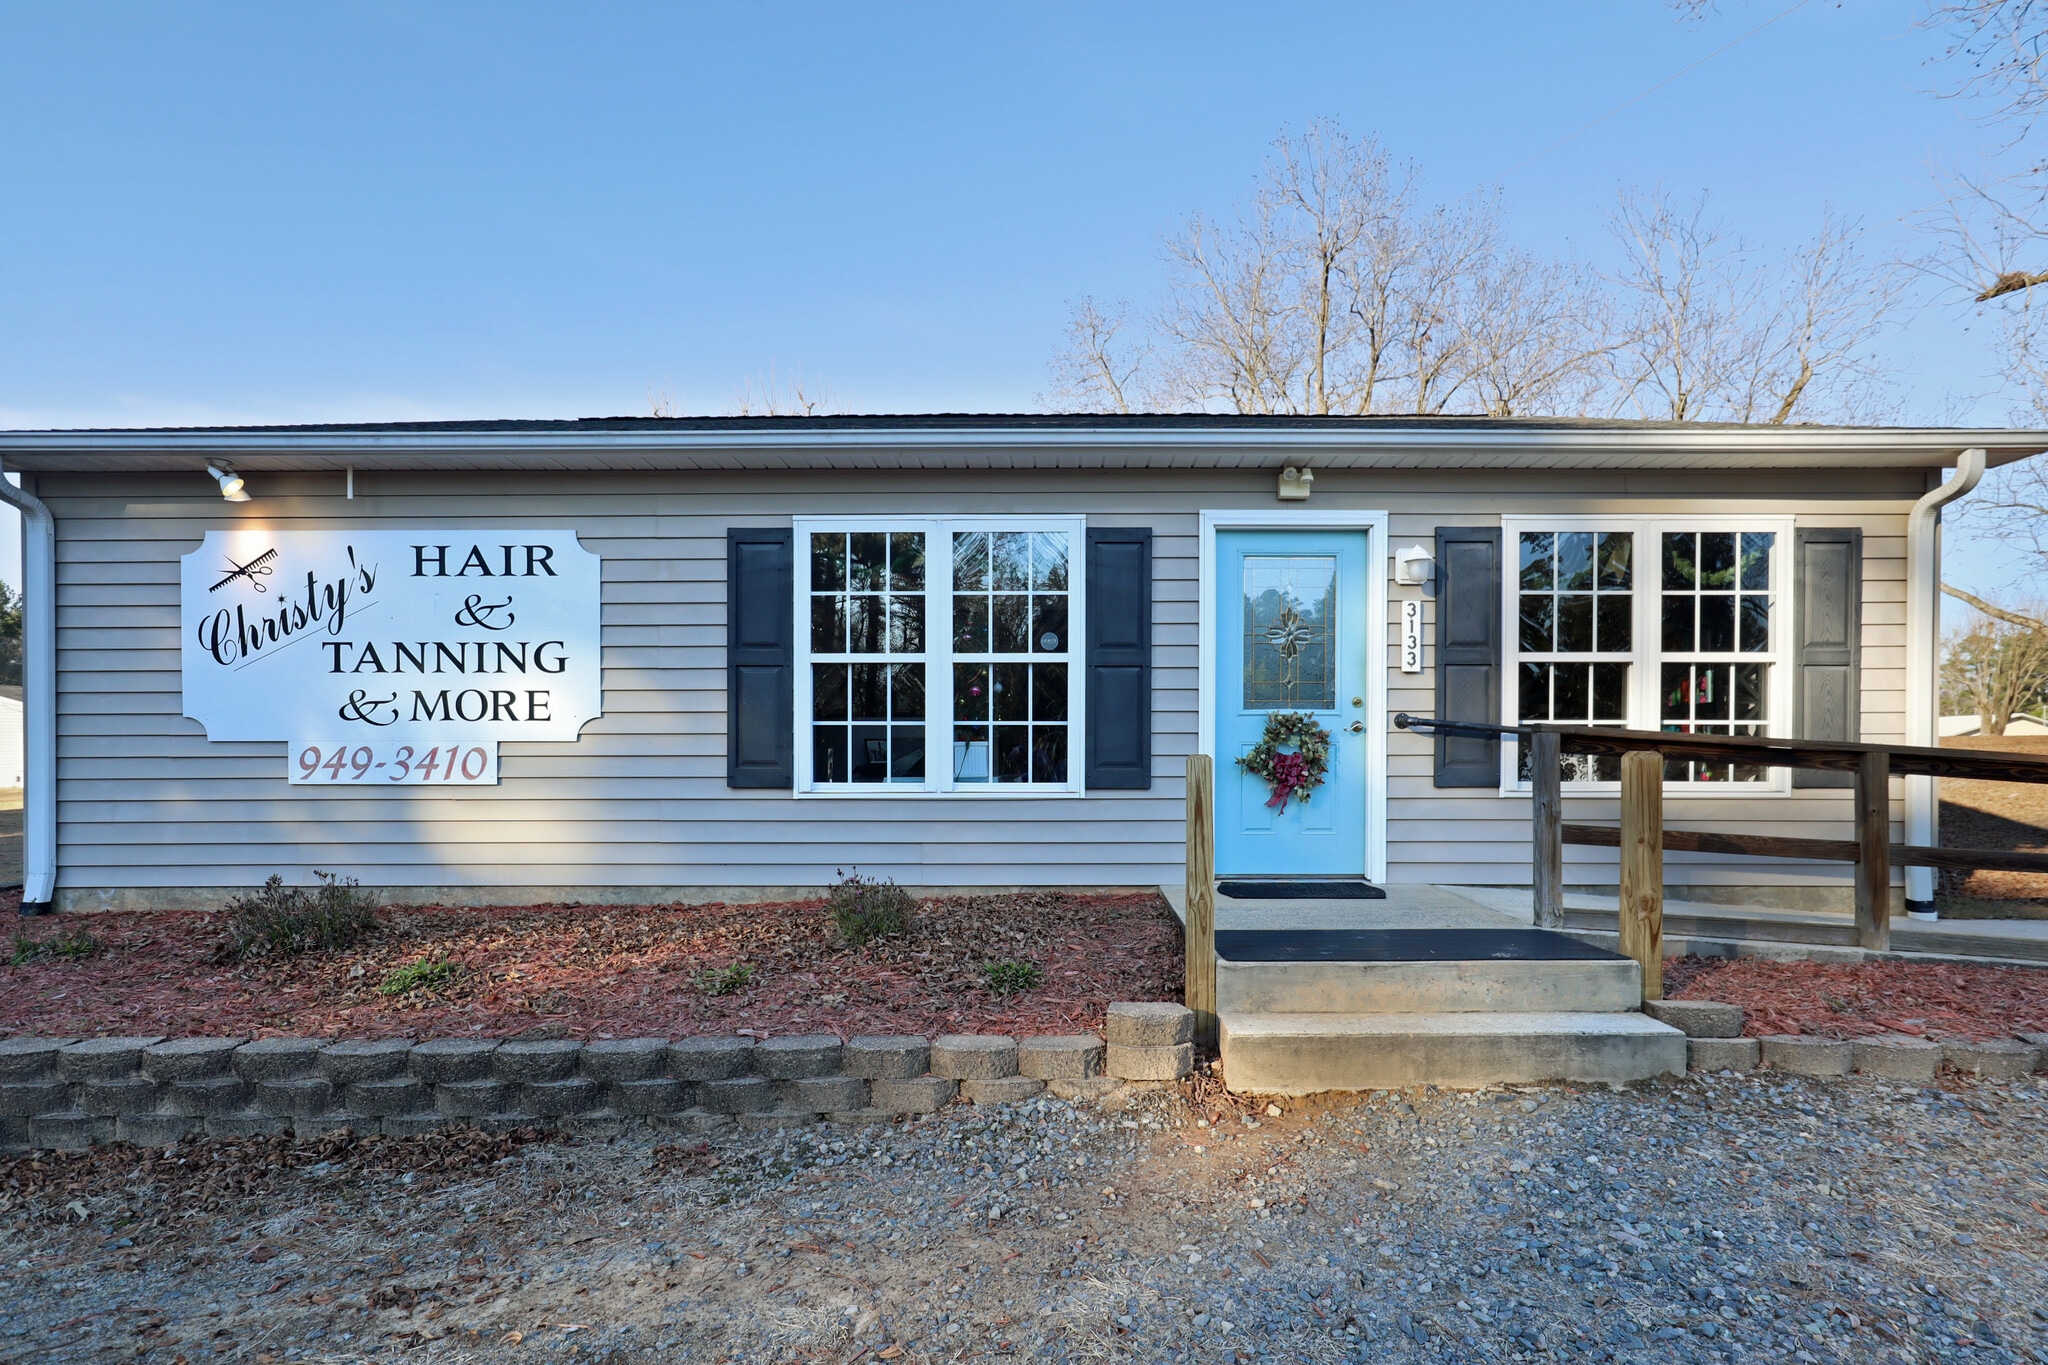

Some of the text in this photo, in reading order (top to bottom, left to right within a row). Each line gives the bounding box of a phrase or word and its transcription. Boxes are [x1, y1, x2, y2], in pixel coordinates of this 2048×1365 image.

[410, 545, 558, 577] HAIR
[198, 545, 378, 665] Christy's
[455, 594, 515, 630] &
[1407, 602, 1417, 667] 3133
[321, 641, 569, 674] TANNING
[338, 689, 552, 726] & MORE
[298, 744, 488, 782] 949-3410
